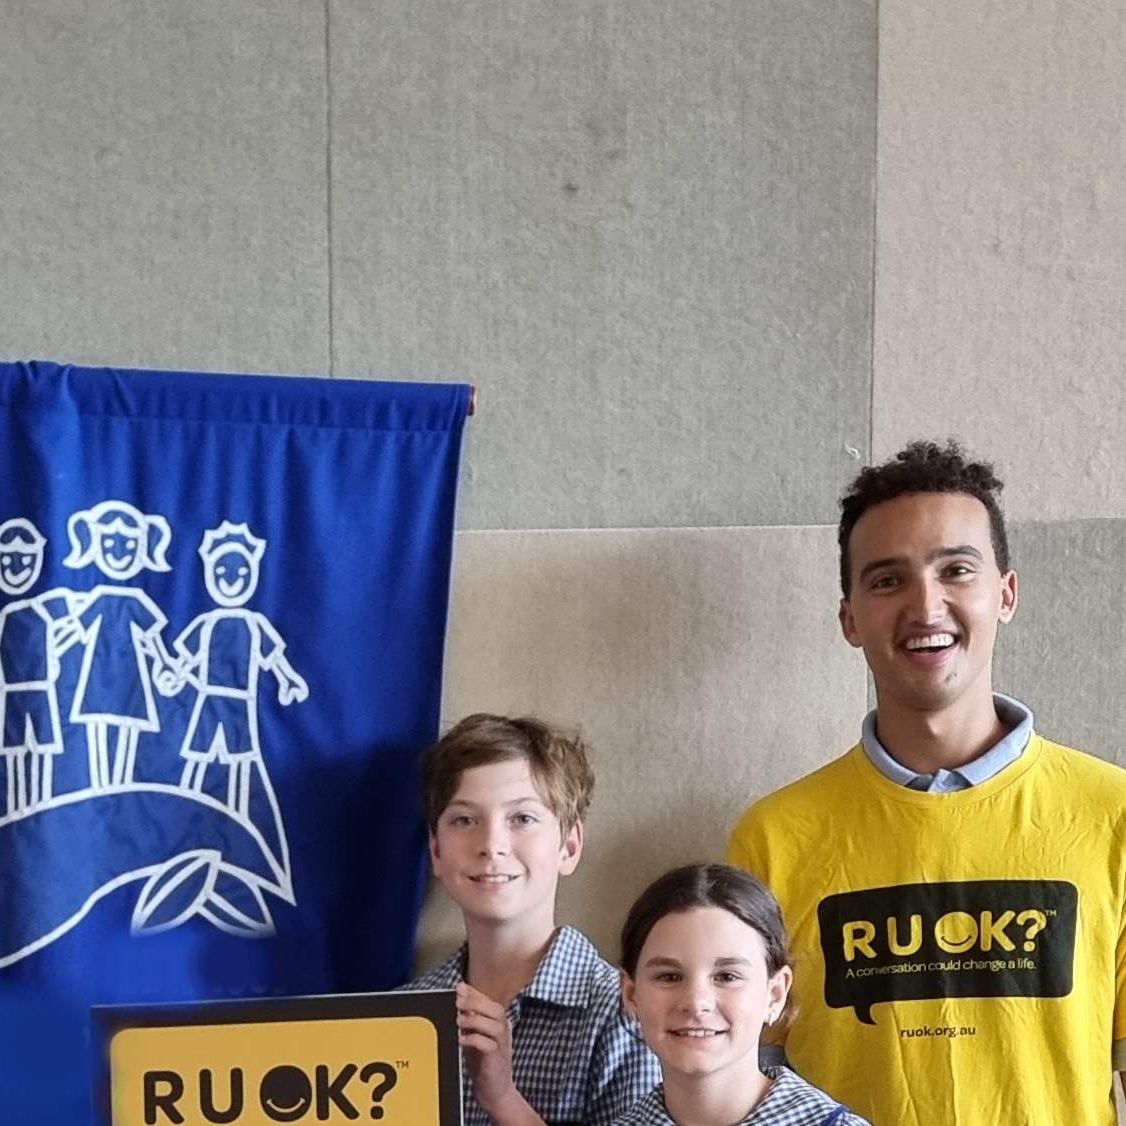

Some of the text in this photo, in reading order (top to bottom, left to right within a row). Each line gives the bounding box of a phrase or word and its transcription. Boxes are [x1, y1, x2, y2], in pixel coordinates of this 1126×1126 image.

[842, 920, 877, 962] R
[887, 914, 923, 956] U
[845, 957, 1037, 979] A conversation could change a life.
[900, 1025, 976, 1038] ruok.org.au
[143, 1070, 185, 1126] R
[199, 1067, 244, 1124] U
